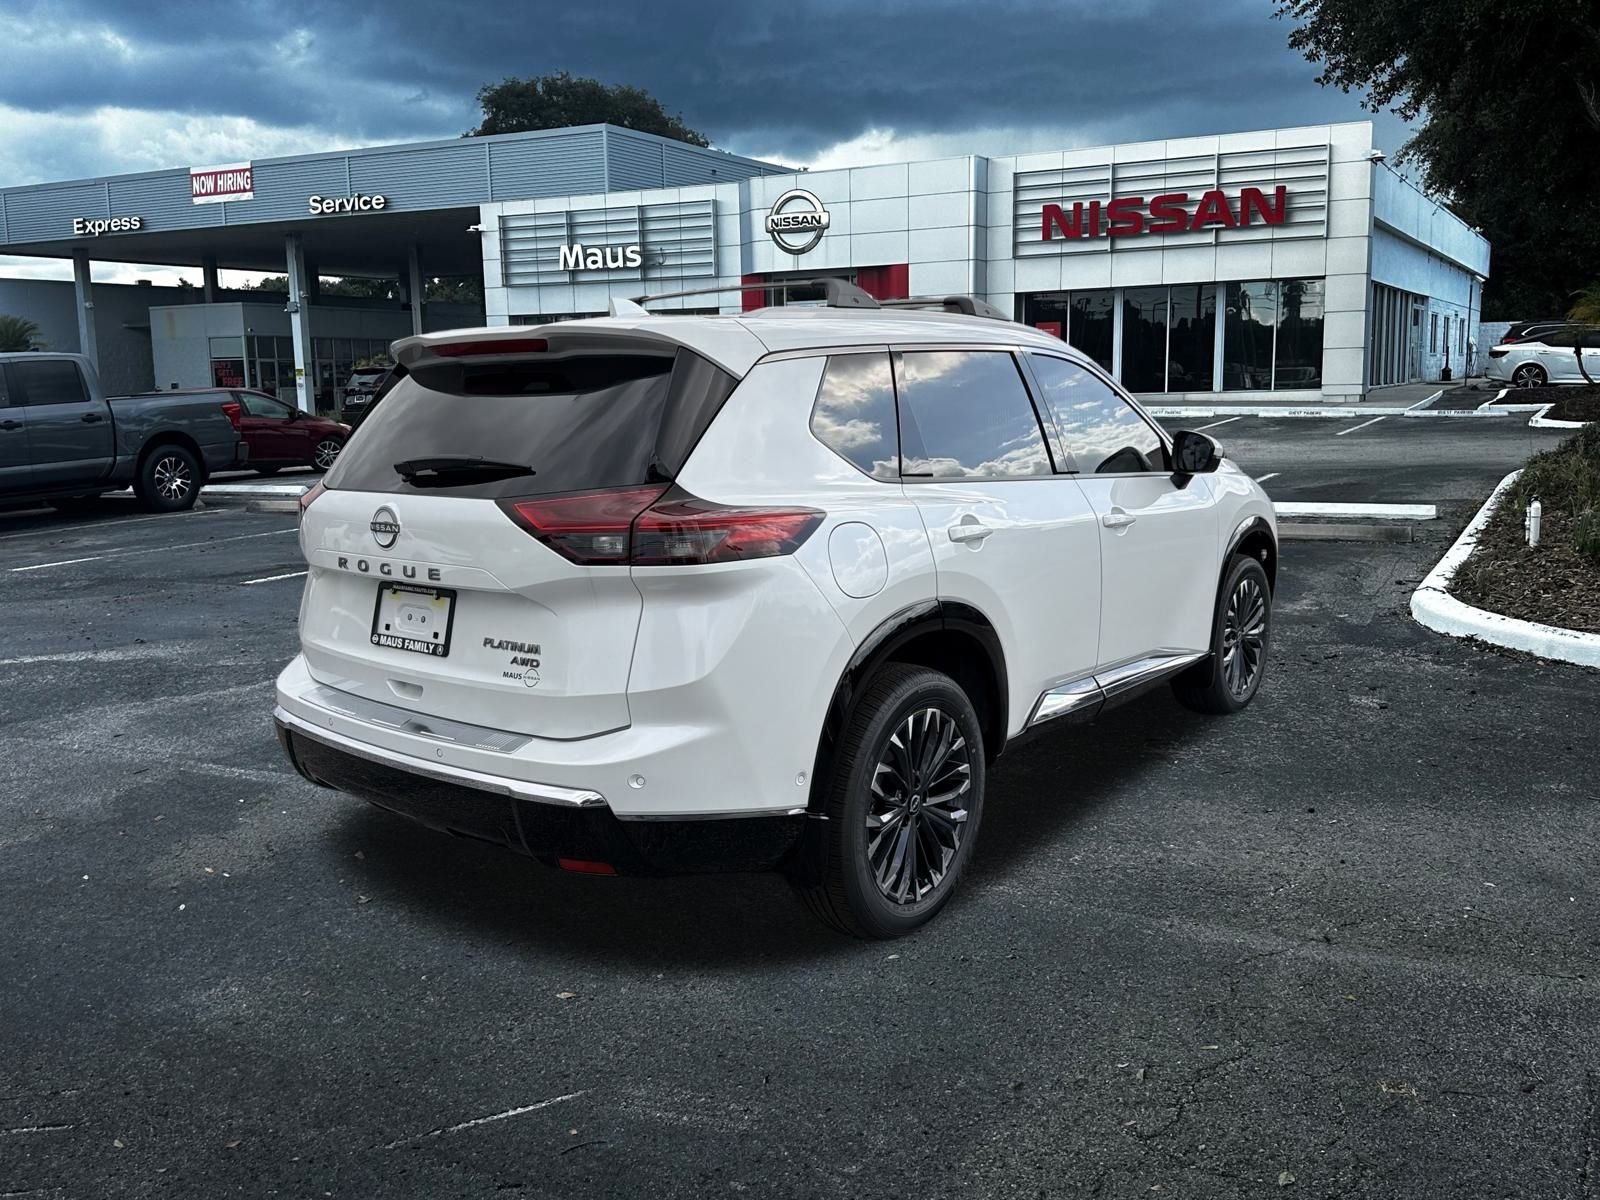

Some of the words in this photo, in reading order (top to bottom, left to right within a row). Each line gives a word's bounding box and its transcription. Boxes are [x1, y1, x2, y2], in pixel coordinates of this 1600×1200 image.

[192, 174, 215, 195] NOW
[217, 171, 251, 192] HIRING
[308, 193, 385, 215] Service
[1042, 185, 1287, 241] NISSAN
[73, 216, 141, 237] Express
[770, 214, 822, 228] NISSAN
[560, 244, 642, 271] Maus
[370, 523, 399, 533] NISSAN
[338, 557, 442, 581] ROGUE
[379, 635, 403, 648] MAUS
[404, 639, 435, 654] FAMILY
[483, 637, 541, 655] PLATINUM
[510, 656, 540, 668] AWD
[503, 671, 522, 680] MAUS
